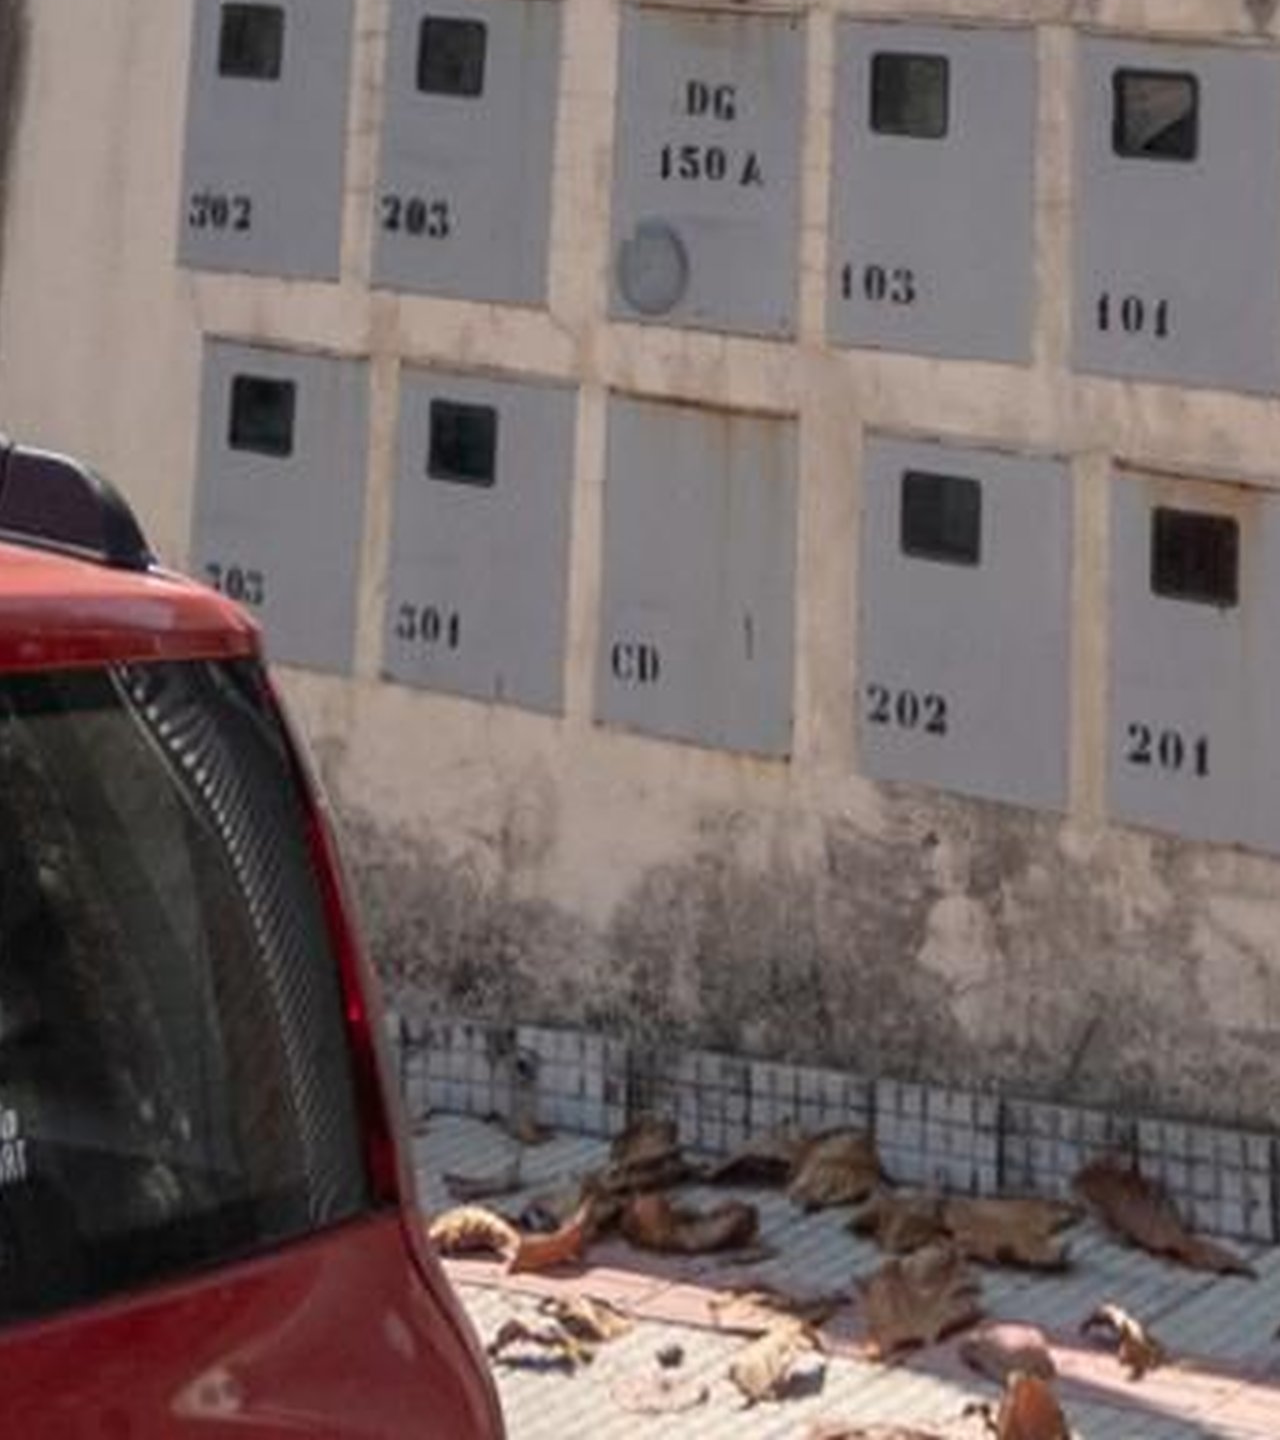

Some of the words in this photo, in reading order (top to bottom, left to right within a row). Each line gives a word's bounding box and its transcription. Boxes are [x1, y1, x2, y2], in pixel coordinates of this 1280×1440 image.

[686, 80, 736, 122] DG
[188, 194, 253, 232] 302
[381, 195, 451, 239] 203
[840, 263, 917, 306] 103
[1096, 291, 1169, 340] 101
[396, 605, 460, 650] 301
[610, 643, 661, 684] CD
[866, 684, 949, 738] 202
[1126, 722, 1210, 779] 201
